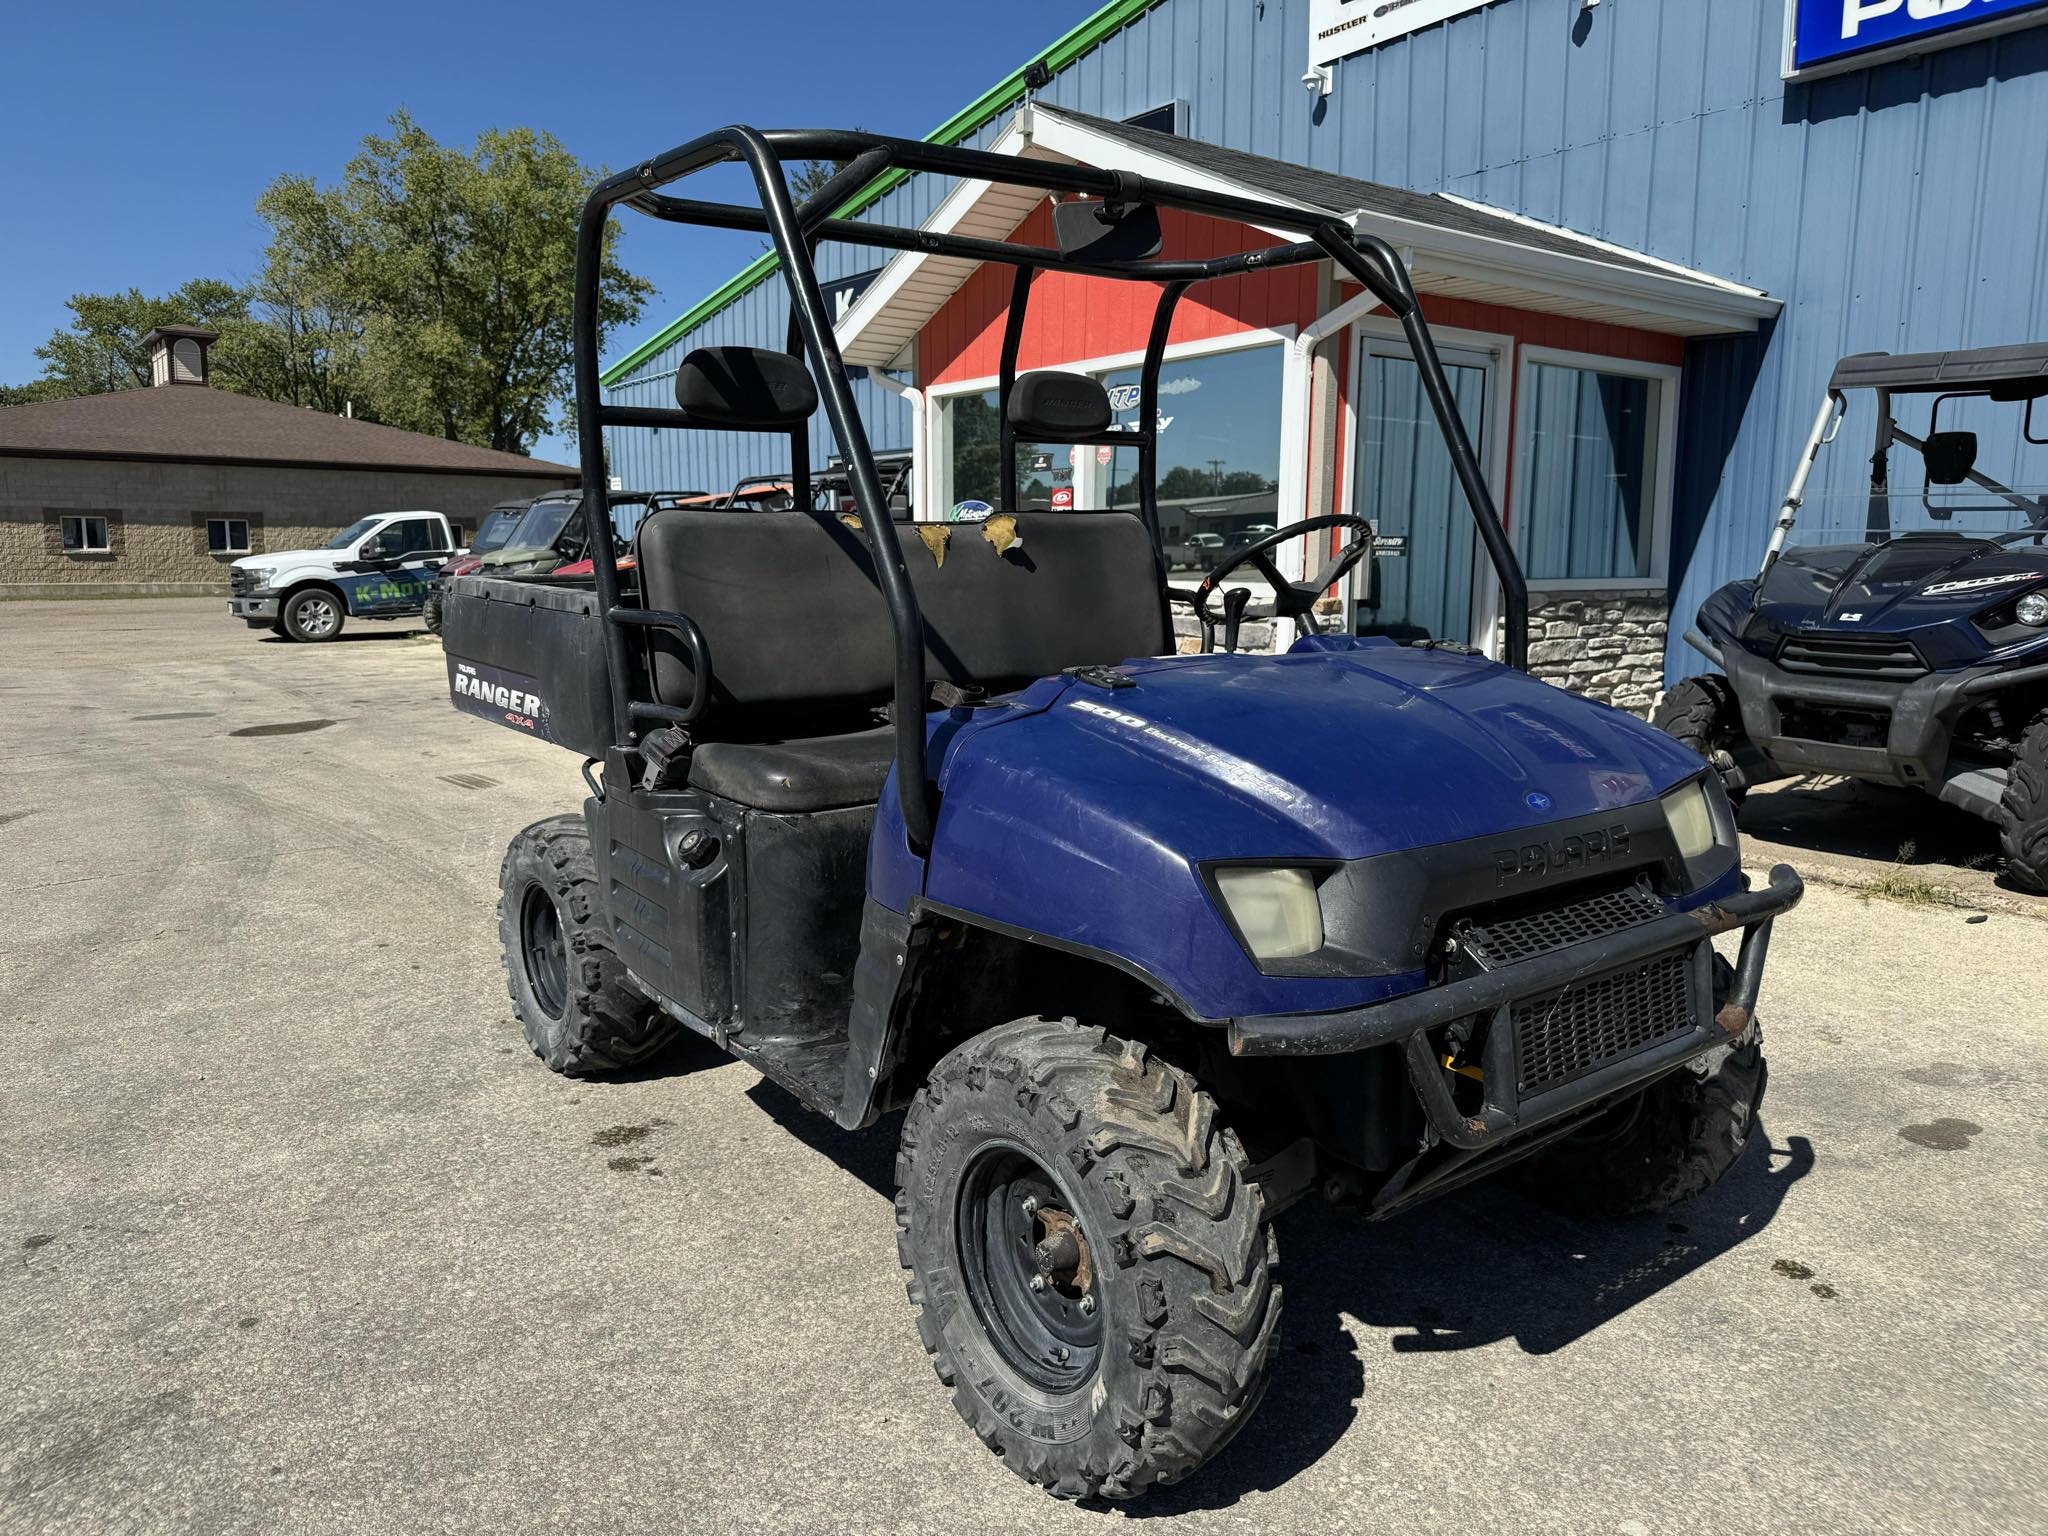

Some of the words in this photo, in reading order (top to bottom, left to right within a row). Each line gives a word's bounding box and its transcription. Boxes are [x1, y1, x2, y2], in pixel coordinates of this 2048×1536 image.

[1318, 15, 1368, 40] HUSTLER
[454, 672, 541, 718] RANGER
[1066, 700, 1148, 728] 500
[1144, 727, 1208, 758] Electronic
[1493, 823, 1632, 889] POLARIS
